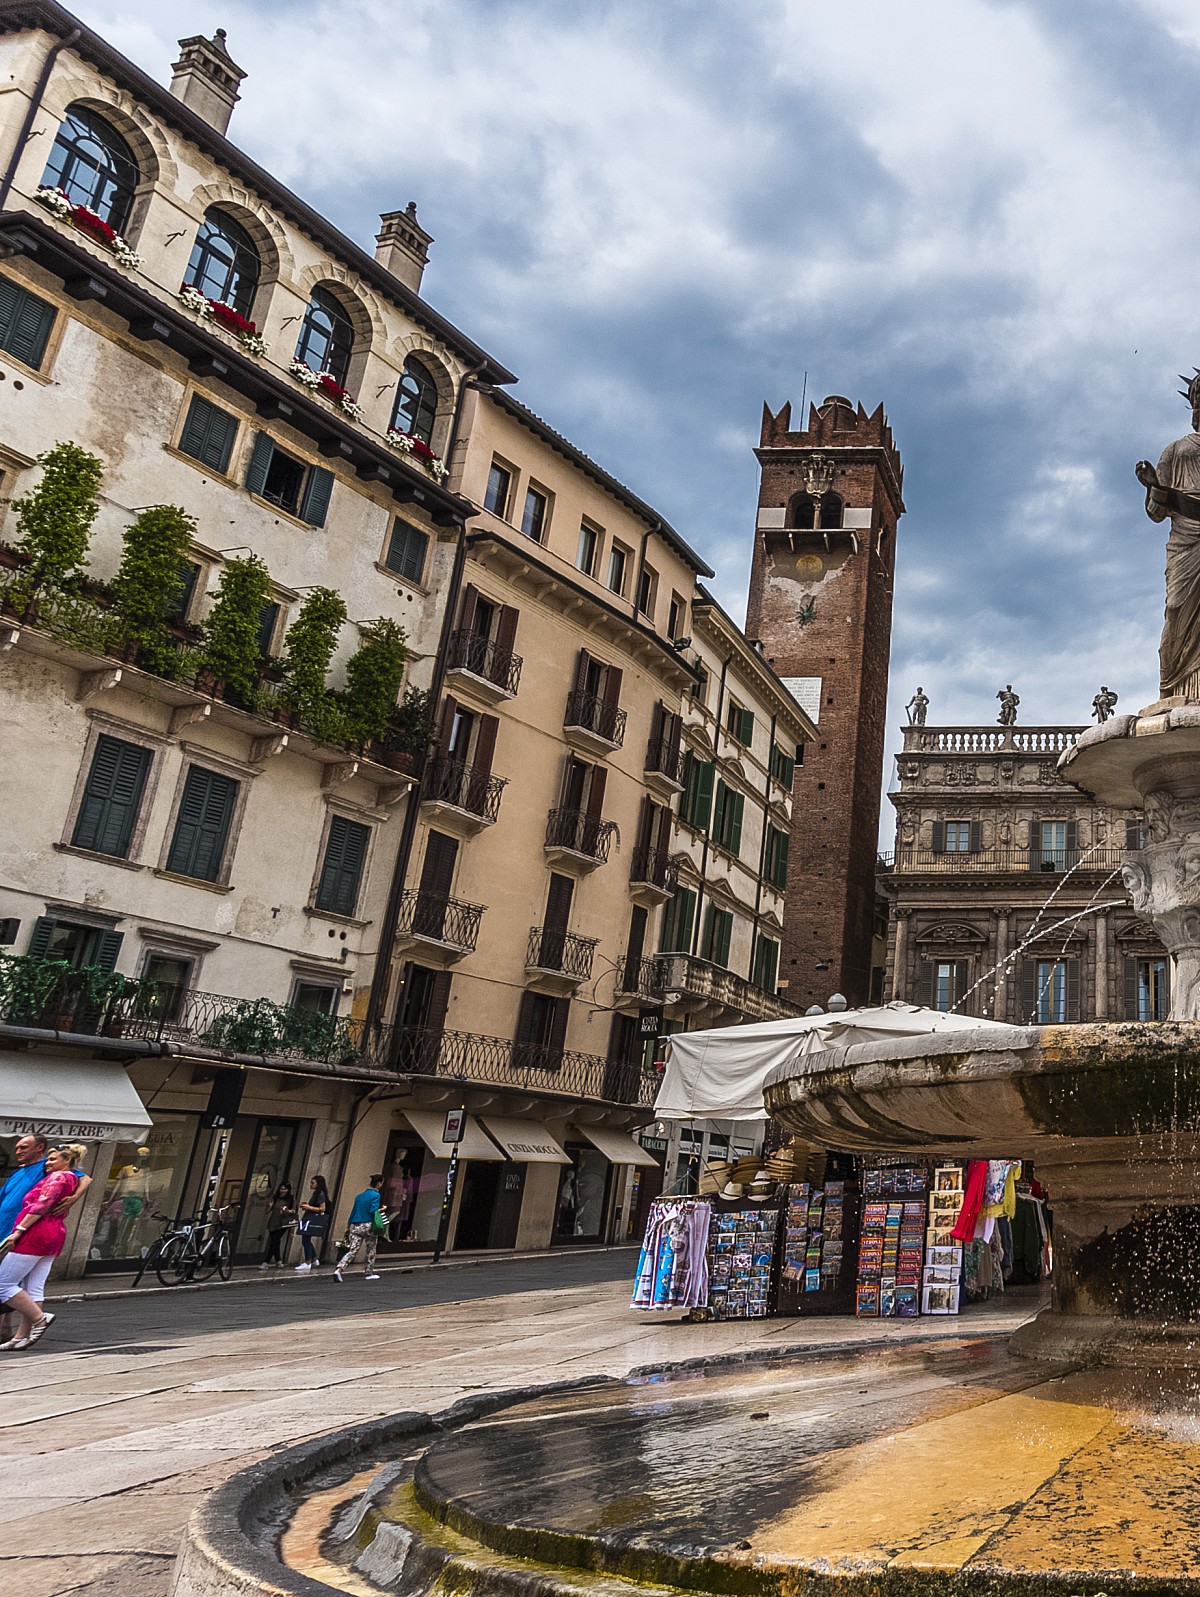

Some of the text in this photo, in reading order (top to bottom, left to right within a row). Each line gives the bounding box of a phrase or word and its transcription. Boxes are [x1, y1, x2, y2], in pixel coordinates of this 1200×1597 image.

[4, 1120, 114, 1138] "PIAZZA ERBE"
[507, 1143, 561, 1155] CINZIA ROCCA
[641, 1137, 667, 1151] TABACCHI
